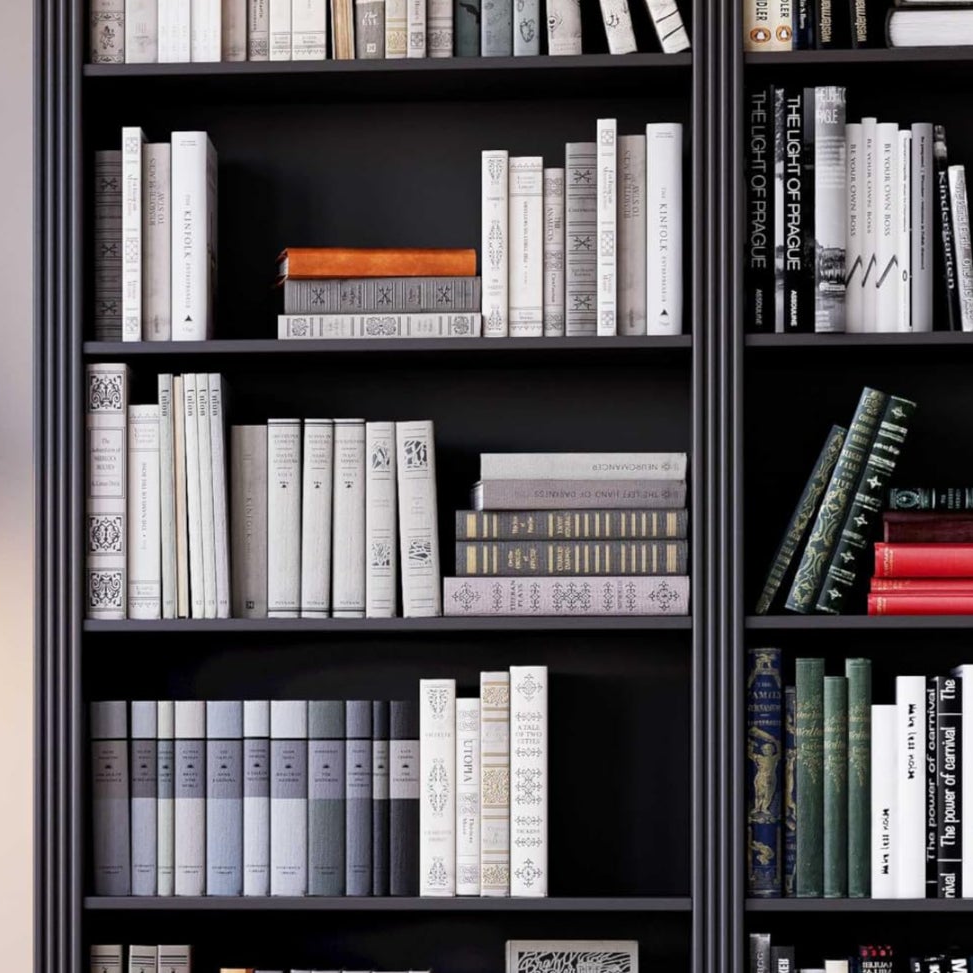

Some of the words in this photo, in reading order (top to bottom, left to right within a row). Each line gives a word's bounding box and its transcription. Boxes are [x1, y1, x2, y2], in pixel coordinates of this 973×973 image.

[751, 91, 766, 124] THE
[786, 95, 801, 128] THE
[751, 126, 766, 172] LIGHT
[786, 130, 801, 176] LIGHT
[850, 143, 857, 154] BE
[884, 143, 891, 154] BE
[751, 174, 766, 198] OF
[786, 178, 801, 201] OF
[659, 203, 668, 252] KINFOLK
[751, 200, 766, 269] PRAGUE
[786, 203, 801, 271] PRAGUE
[938, 171, 955, 290] Kindergarten
[940, 679, 956, 701] The
[927, 688, 936, 751] carnival
[463, 740, 473, 783] UTOPIA
[927, 754, 936, 773] of
[940, 726, 956, 768] carnival
[941, 771, 956, 786] of
[927, 778, 937, 827] power
[944, 789, 960, 823] power
[927, 832, 936, 862] The
[940, 825, 956, 848] The
